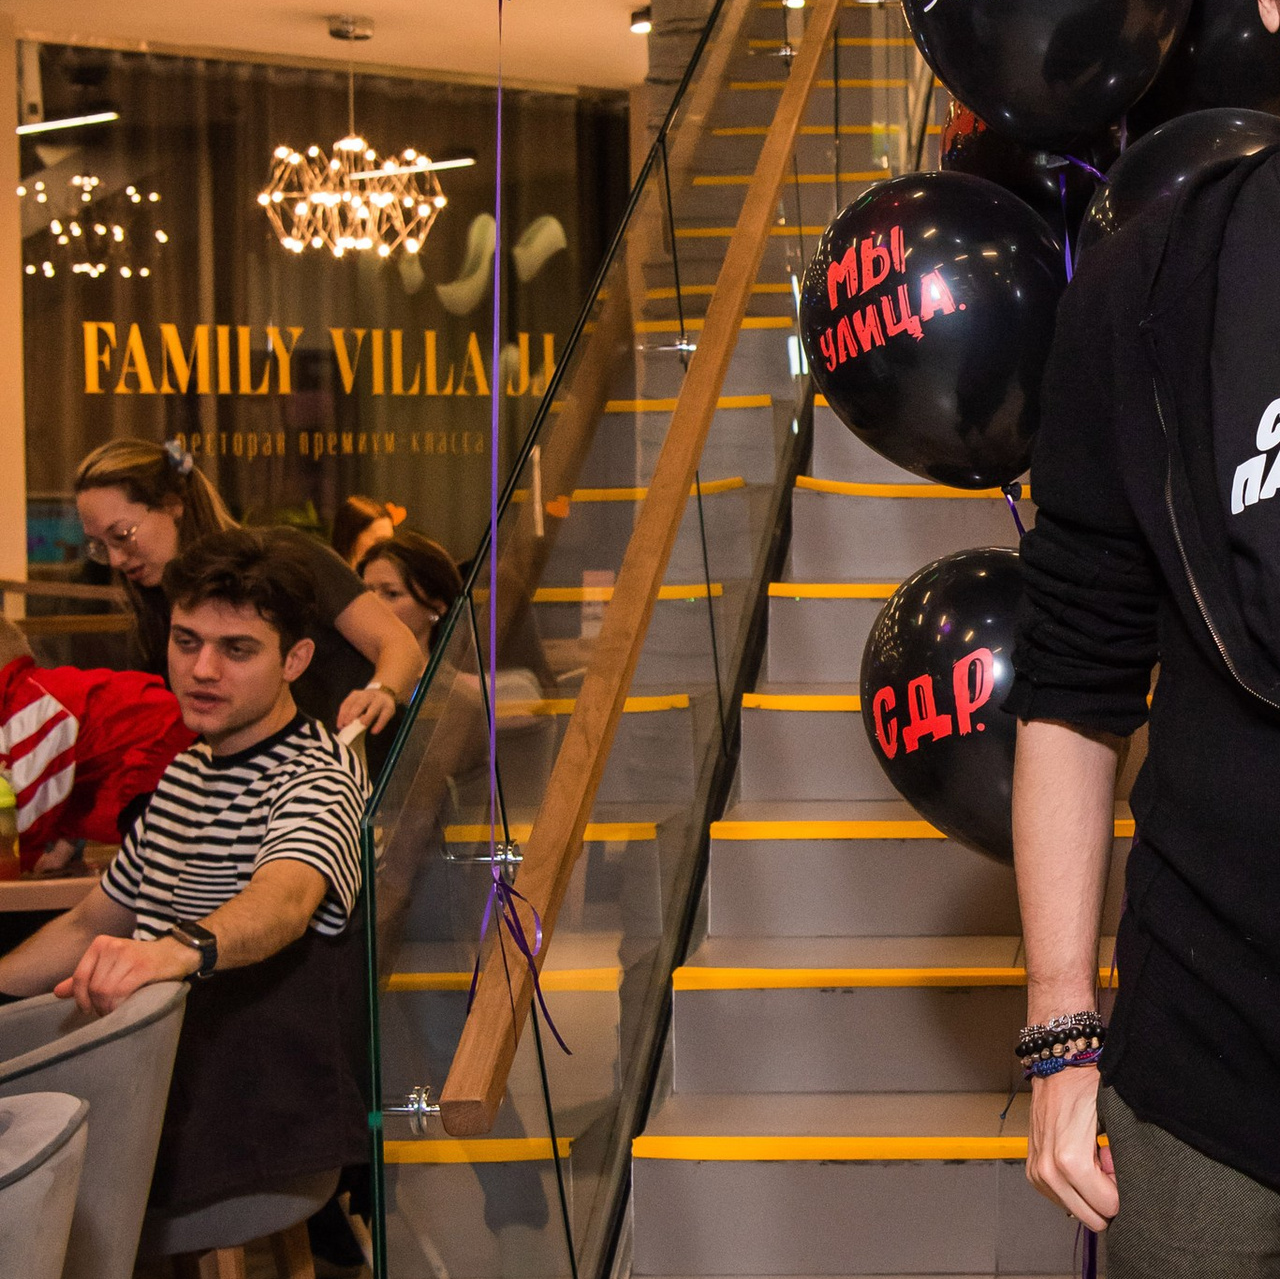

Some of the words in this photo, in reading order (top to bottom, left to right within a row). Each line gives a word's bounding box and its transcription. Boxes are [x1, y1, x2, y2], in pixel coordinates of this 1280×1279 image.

[826, 225, 906, 311] МЫ
[82, 321, 305, 396] FAMILY
[818, 268, 968, 372] УЛИЦА.
[872, 647, 996, 760] СДР.
